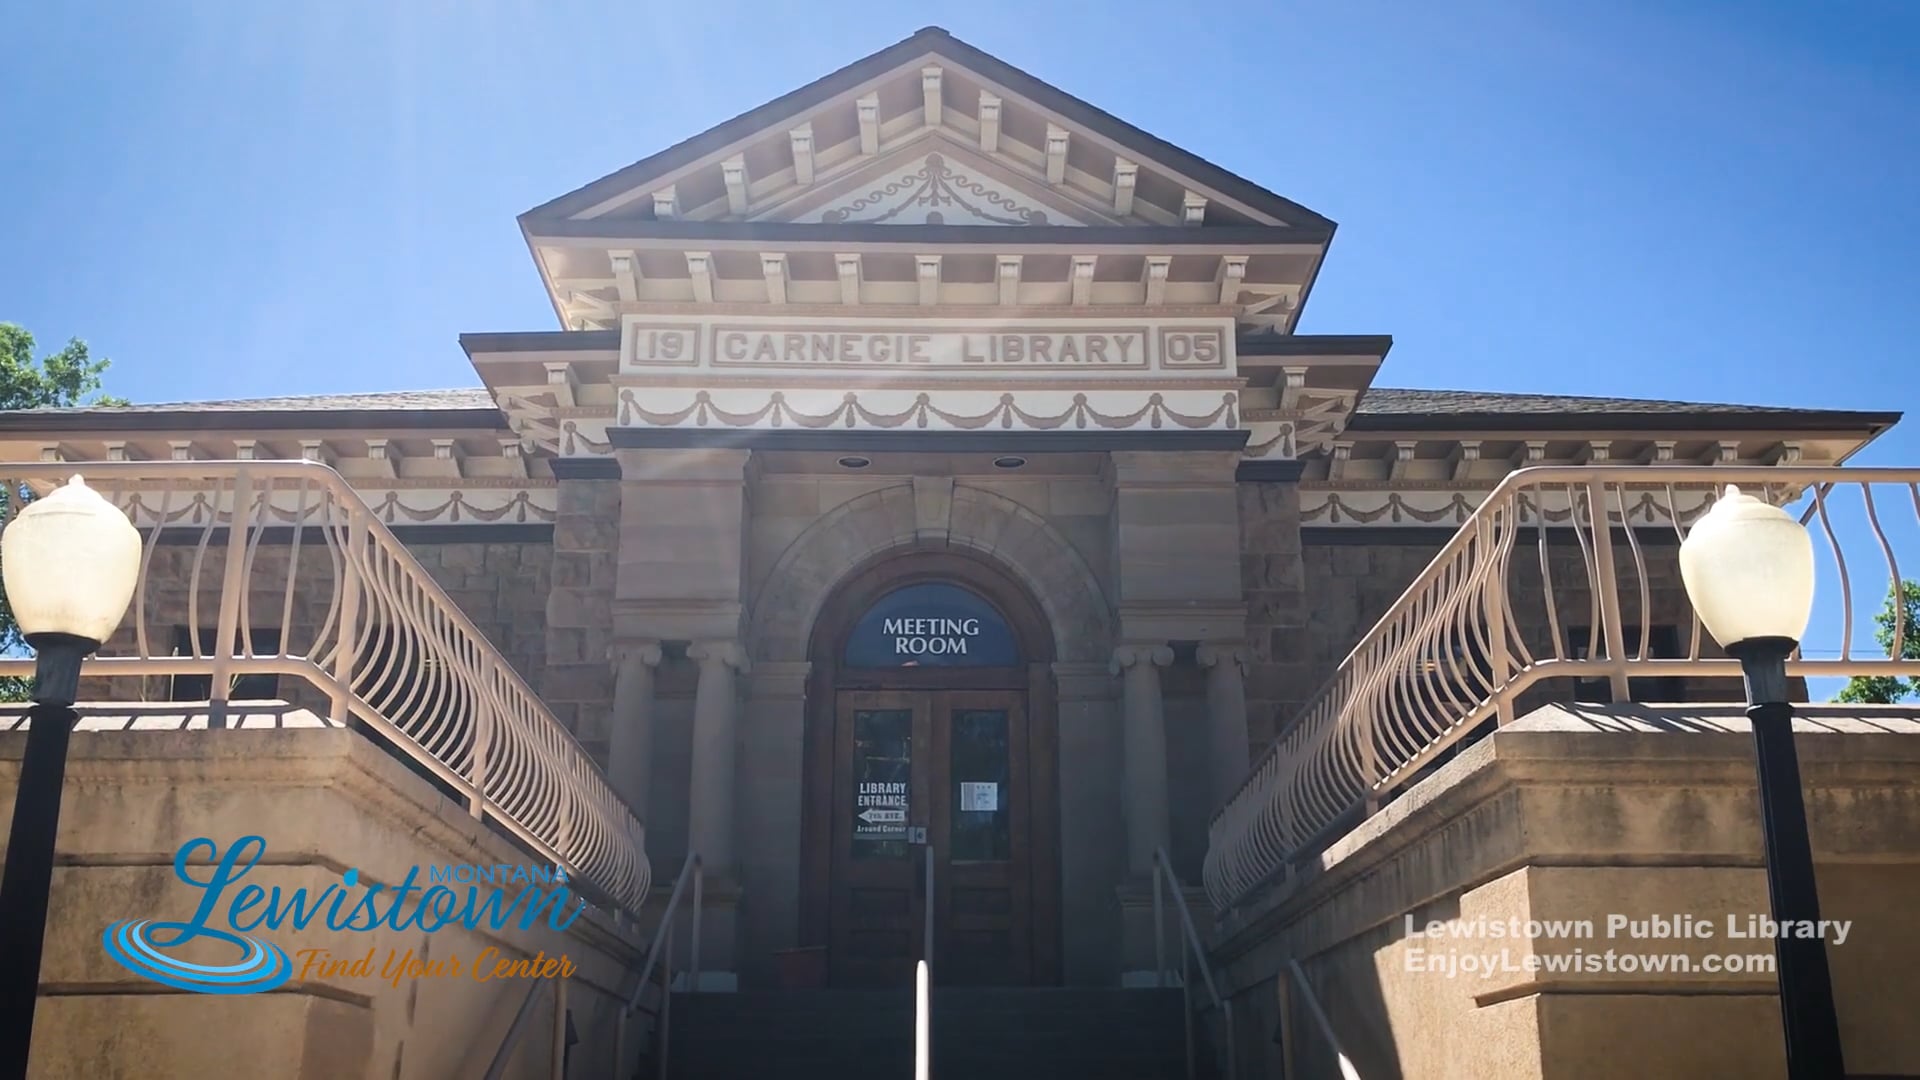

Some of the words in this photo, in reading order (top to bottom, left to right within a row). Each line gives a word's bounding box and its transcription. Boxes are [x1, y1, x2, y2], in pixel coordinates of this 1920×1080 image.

[647, 332, 684, 359] 19
[724, 333, 931, 363] CARNEGIE
[961, 333, 1136, 363] LIBRARY
[1166, 334, 1218, 362] 05
[883, 618, 979, 636] MEETING
[895, 637, 968, 655] ROOM
[859, 782, 906, 794] LIBRARY
[857, 795, 907, 807] ENTRANCE
[856, 825, 881, 833] Around
[882, 825, 906, 833] Corner
